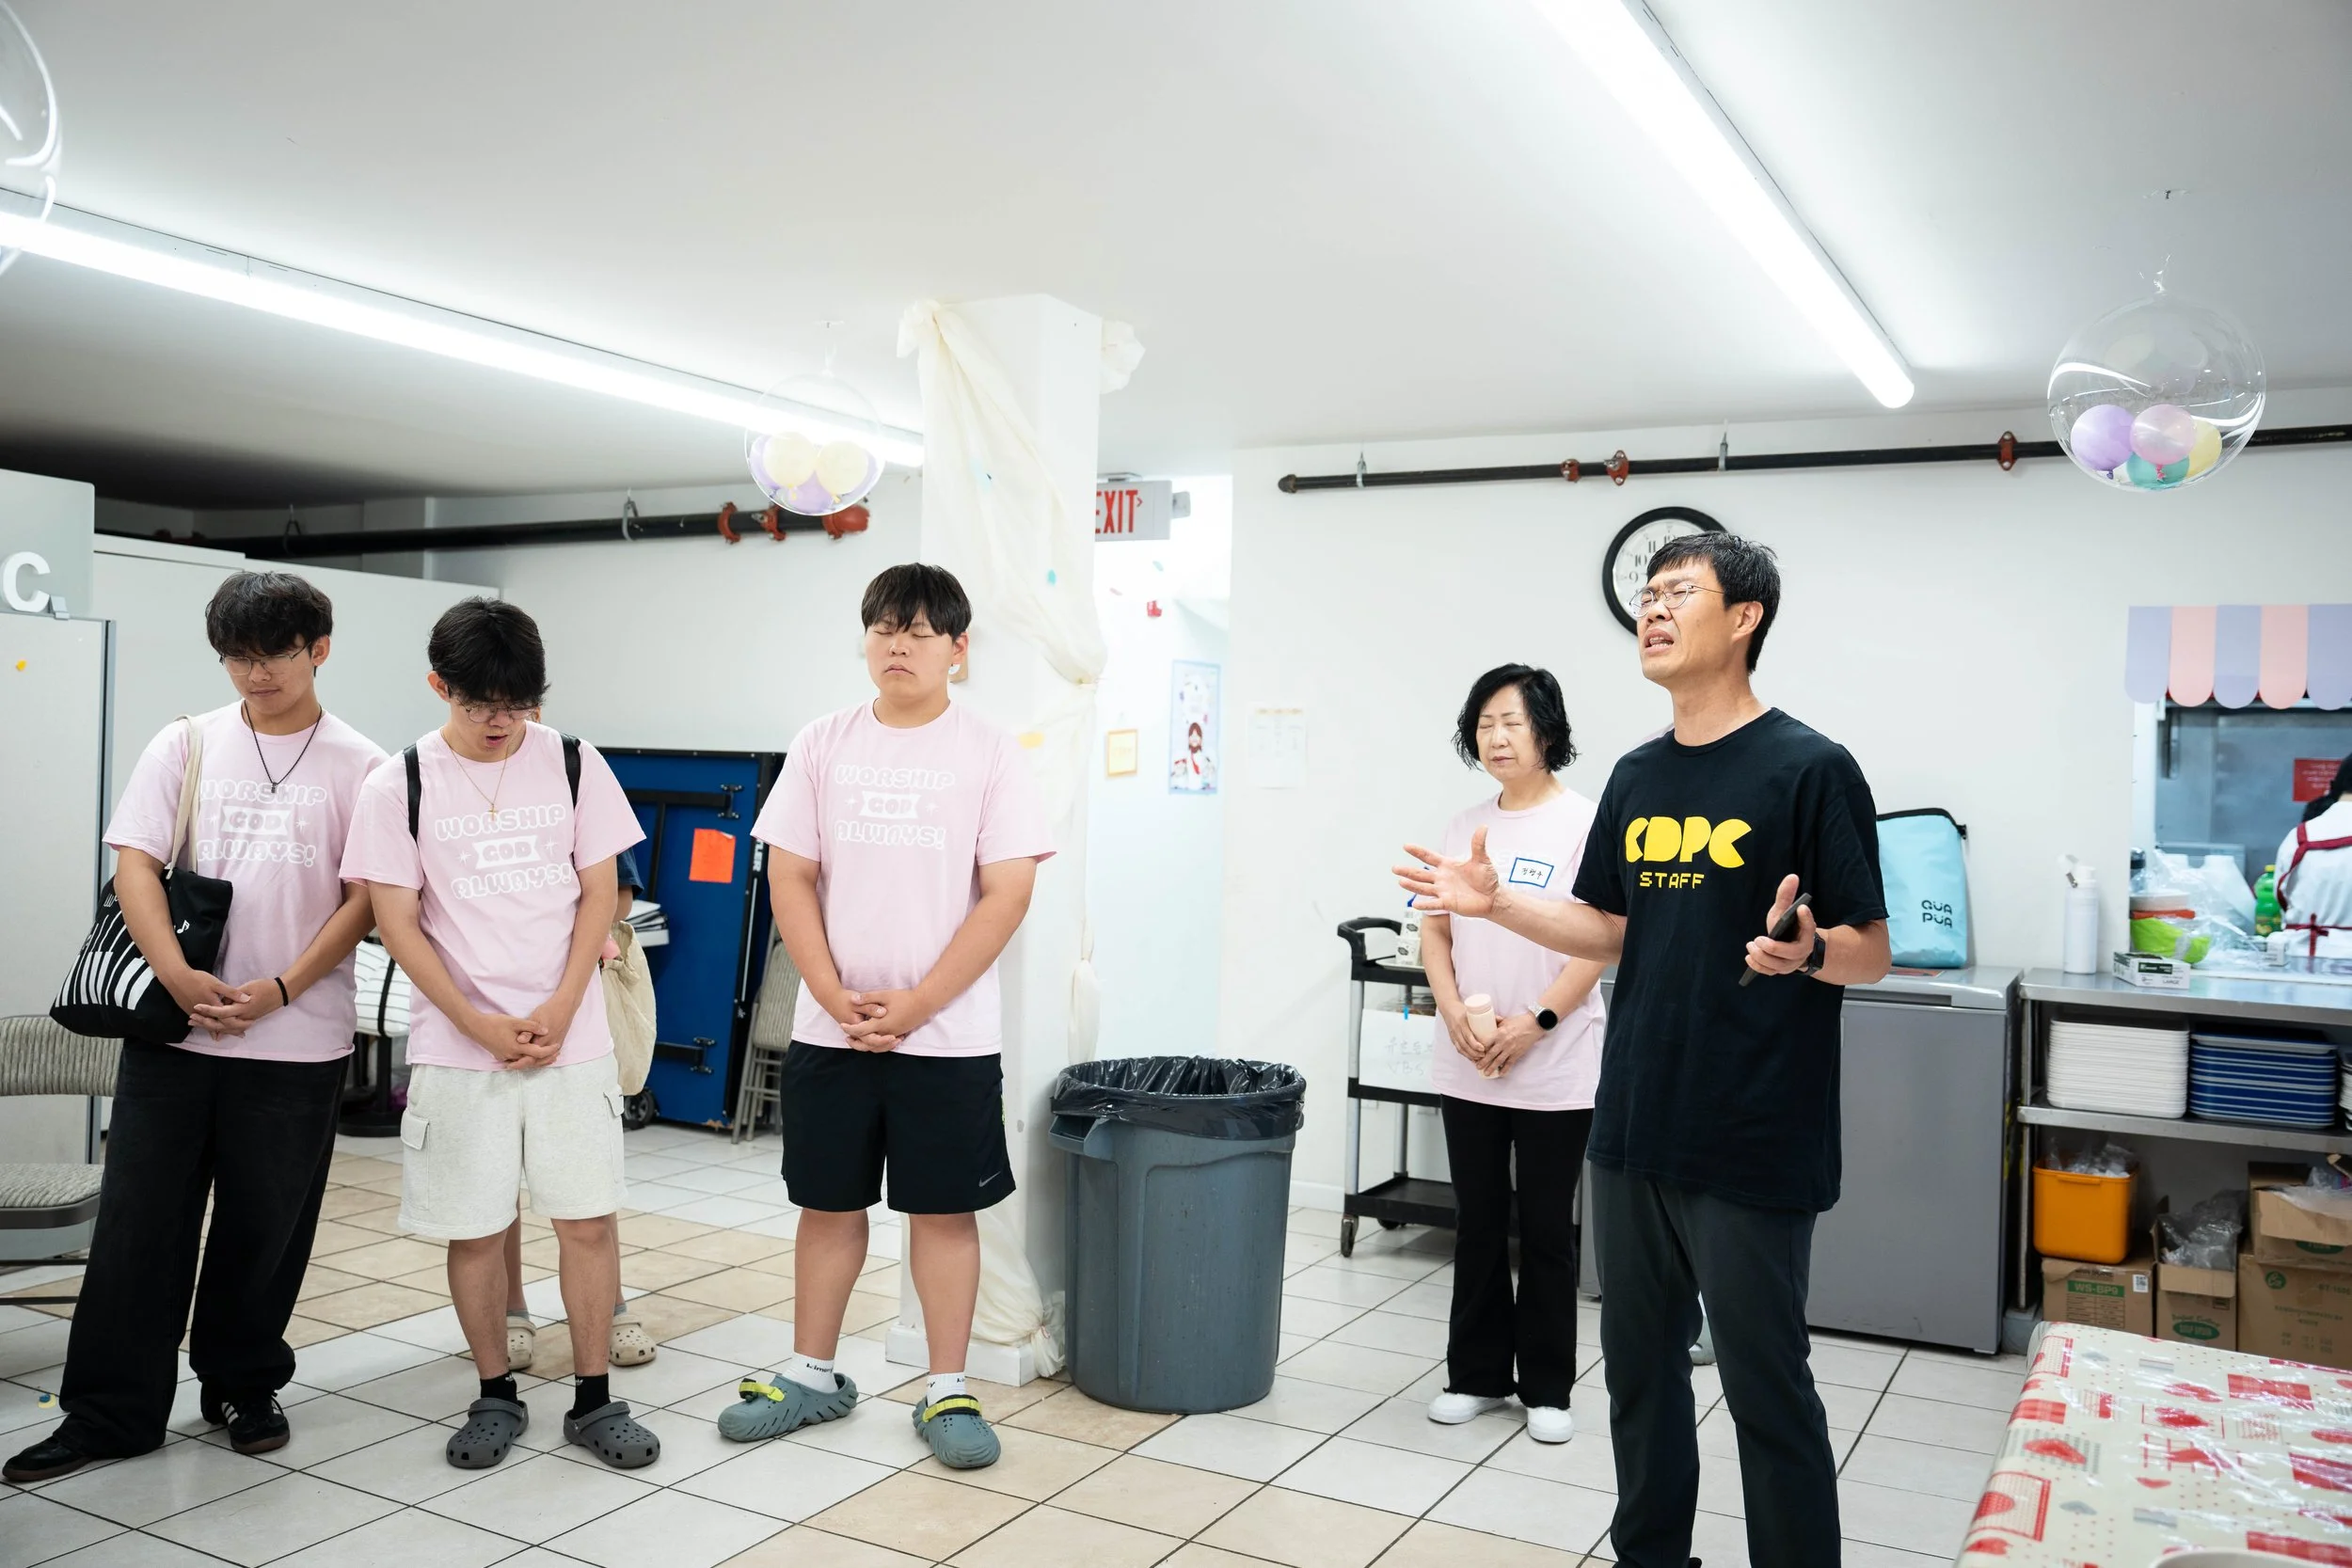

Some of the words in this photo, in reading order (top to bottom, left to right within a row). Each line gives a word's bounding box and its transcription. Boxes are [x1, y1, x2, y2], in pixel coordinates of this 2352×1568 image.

[1648, 541, 1657, 553] 11
[1635, 555, 1647, 567] 10
[3, 551, 51, 613] C
[1629, 571, 1638, 582] 9
[834, 765, 956, 790] WORSHIP
[866, 797, 914, 815] GOD
[229, 811, 283, 830] GOD
[435, 804, 565, 841] WORSHIP
[834, 819, 946, 850] ALWAYS!
[1625, 816, 1753, 869] CDPC
[196, 838, 317, 867] ALWAYS!
[482, 841, 532, 863] GOD
[451, 863, 572, 899] ALWAYS!
[1639, 871, 1705, 889] STAFF
